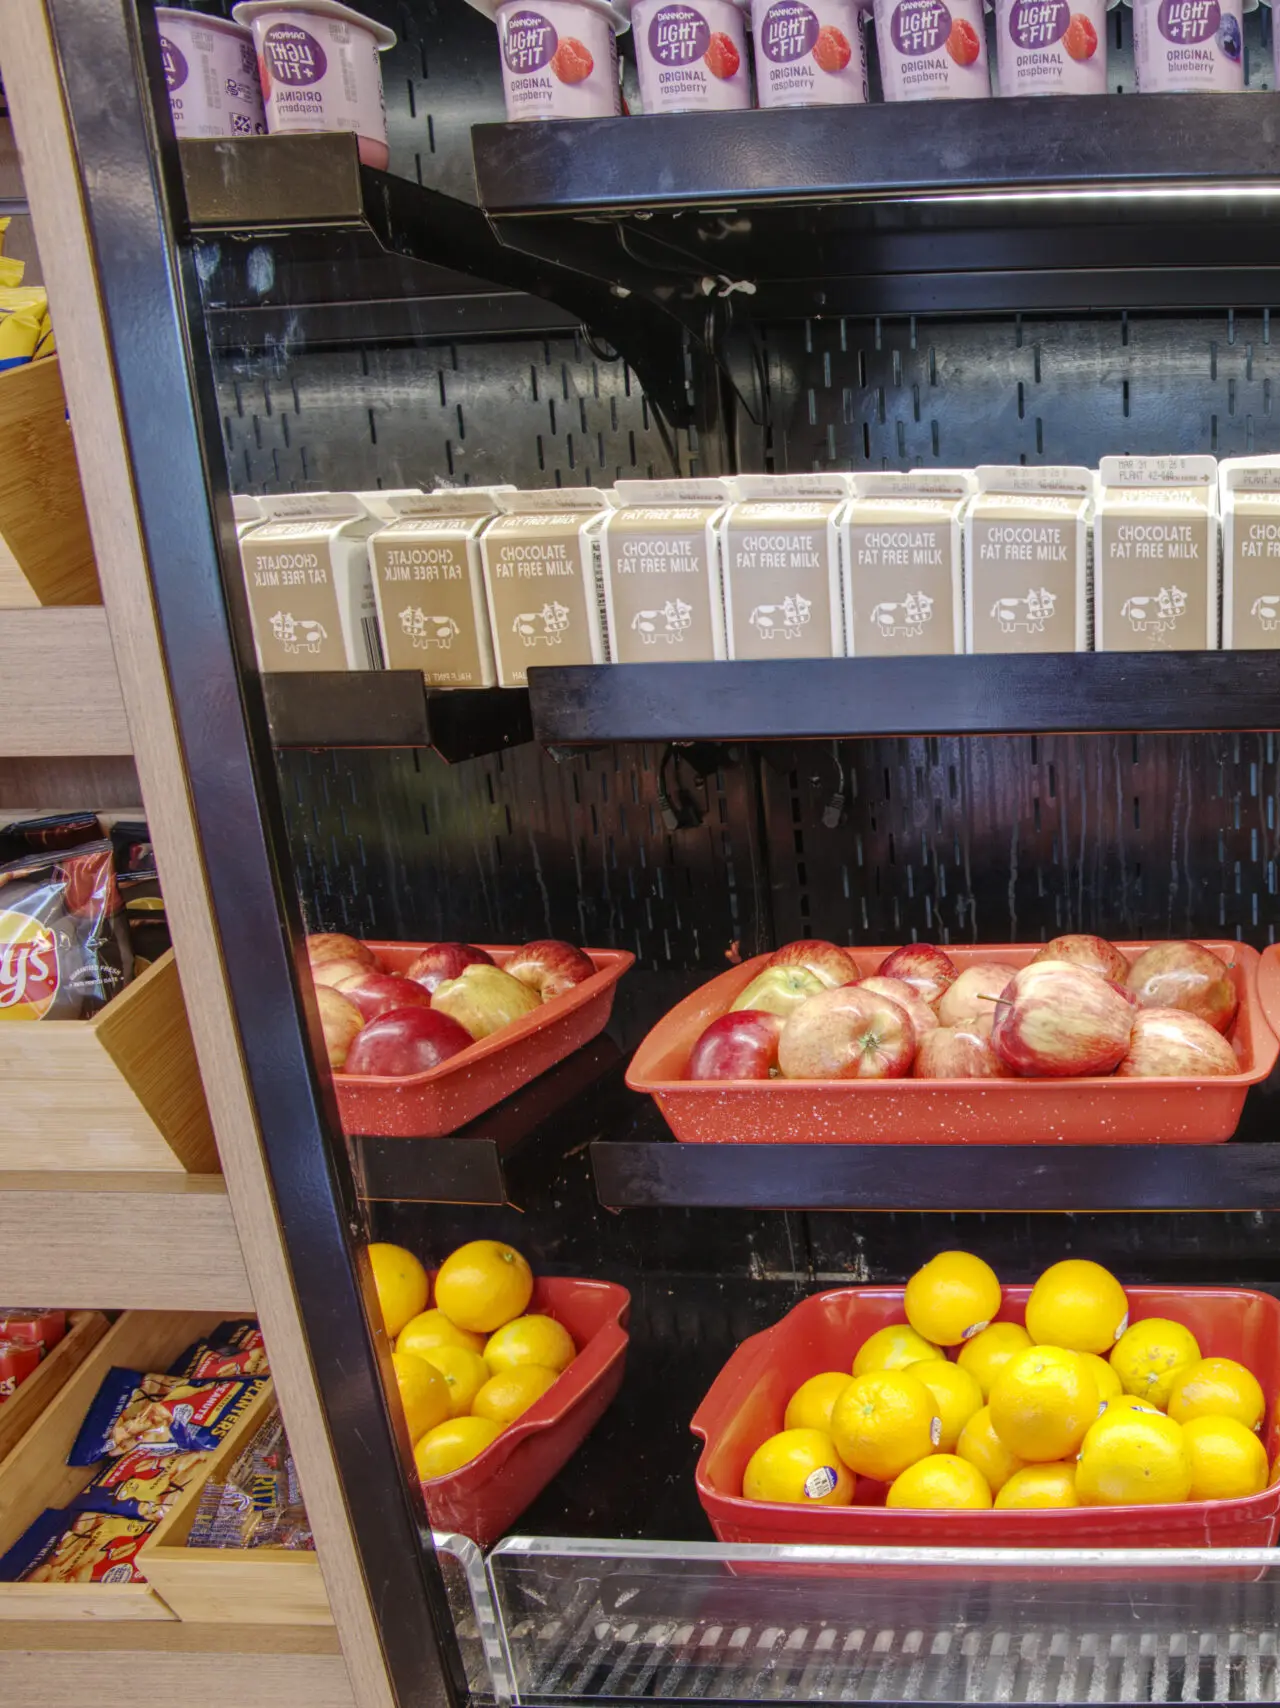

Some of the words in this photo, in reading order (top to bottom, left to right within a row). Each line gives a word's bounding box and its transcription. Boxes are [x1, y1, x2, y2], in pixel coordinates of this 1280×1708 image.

[1018, 5, 1058, 29] LIGHT
[1169, 0, 1210, 25] LIGHT
[768, 16, 811, 43] LIGHT
[900, 9, 941, 37] LIGHT
[508, 28, 544, 55] LIGHT
[657, 21, 699, 47] LIGHT
[1016, 54, 1063, 66] ORIGINAL
[1167, 50, 1214, 61] ORIGINAL
[770, 67, 814, 78] ORIGINAL
[901, 59, 948, 73] ORIGINAL
[1018, 64, 1062, 77] raspberry
[1168, 61, 1214, 73] blueberry
[511, 78, 552, 91] ORIGINAL
[659, 71, 706, 83] ORIGINAL
[771, 78, 814, 91] raspberry
[903, 72, 948, 84] raspberry
[512, 89, 552, 103] raspberry
[661, 82, 707, 95] raspberry
[865, 533, 935, 548] CHOCOLATE
[988, 528, 1060, 544] CHOCOLATE
[1118, 526, 1191, 541] CHOCOLATE
[623, 540, 692, 556] CHOCOLATE
[742, 536, 813, 551] CHOCOLATE
[1110, 543, 1132, 558] FAT
[1136, 542, 1164, 558] FREE
[1169, 543, 1199, 558] MILK
[1242, 542, 1263, 557] FAT
[501, 544, 566, 560] CHOCOLATE
[858, 550, 879, 564] FAT
[883, 550, 909, 564] FREE
[913, 550, 942, 565] MILK
[980, 545, 1001, 560] FAT
[1005, 545, 1032, 560] FREE
[1037, 546, 1067, 560] MILK
[618, 558, 636, 573] FAT
[640, 558, 666, 572] FREE
[671, 557, 699, 572] MILK
[736, 553, 756, 567] FAT
[761, 553, 786, 568] FREE
[790, 553, 820, 568] MILK
[496, 563, 514, 578] FAT
[518, 561, 542, 576] FREE
[546, 560, 574, 576] MILK
[211, 1379, 266, 1437] PLANTERS
